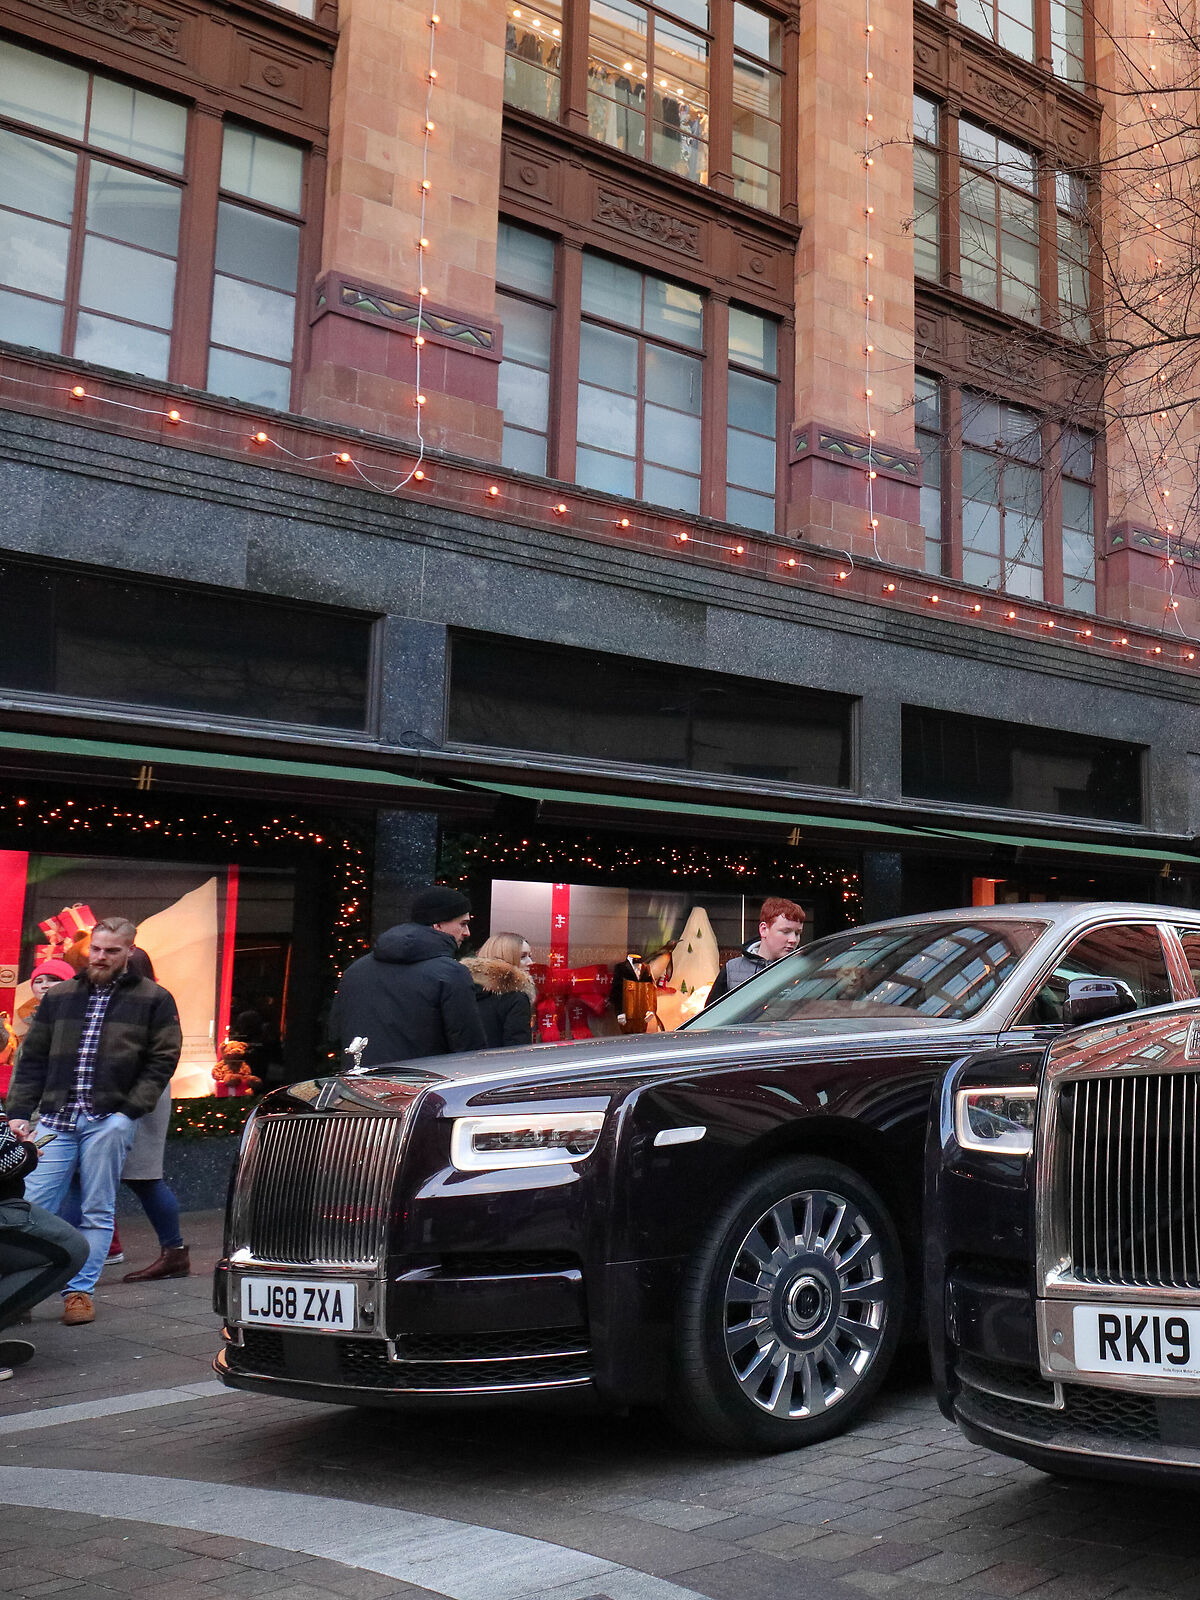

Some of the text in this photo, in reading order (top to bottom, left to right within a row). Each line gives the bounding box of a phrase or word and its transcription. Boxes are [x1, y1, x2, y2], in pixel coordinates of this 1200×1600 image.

[248, 1284, 344, 1323] LJ68 ZXA
[1098, 1314, 1190, 1365] RK19
